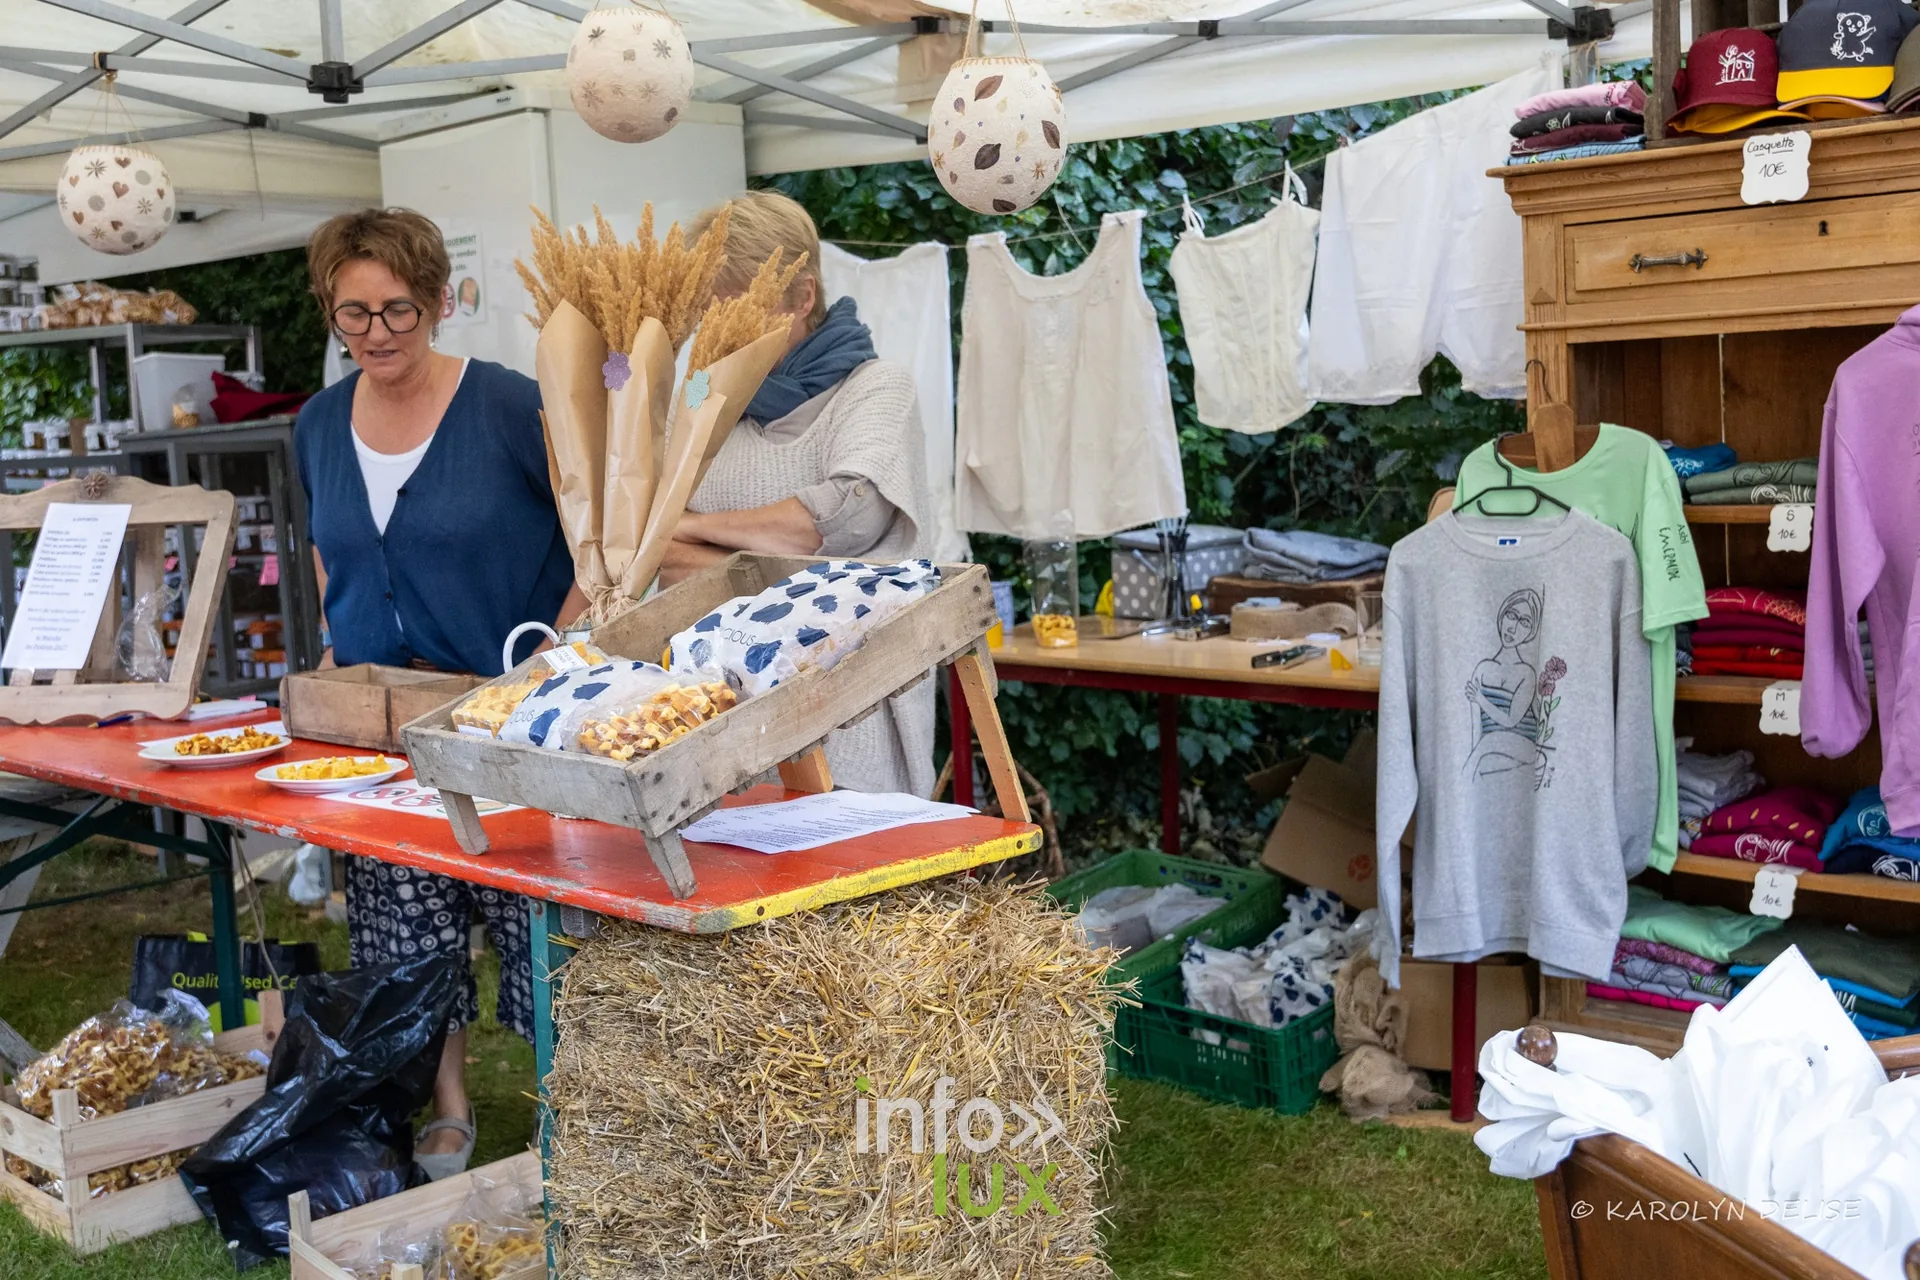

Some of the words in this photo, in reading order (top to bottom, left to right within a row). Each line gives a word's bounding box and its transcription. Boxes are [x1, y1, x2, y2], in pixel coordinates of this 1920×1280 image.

[1747, 136, 1795, 154] Casquette
[1758, 161, 1787, 178] 10€
[1786, 509, 1795, 522] S
[1777, 528, 1797, 540] 10€
[1775, 691, 1786, 702] M
[1762, 893, 1783, 907] 10€
[172, 972, 219, 990] Qualit
[241, 974, 272, 990] sed
[279, 974, 297, 990] Ca
